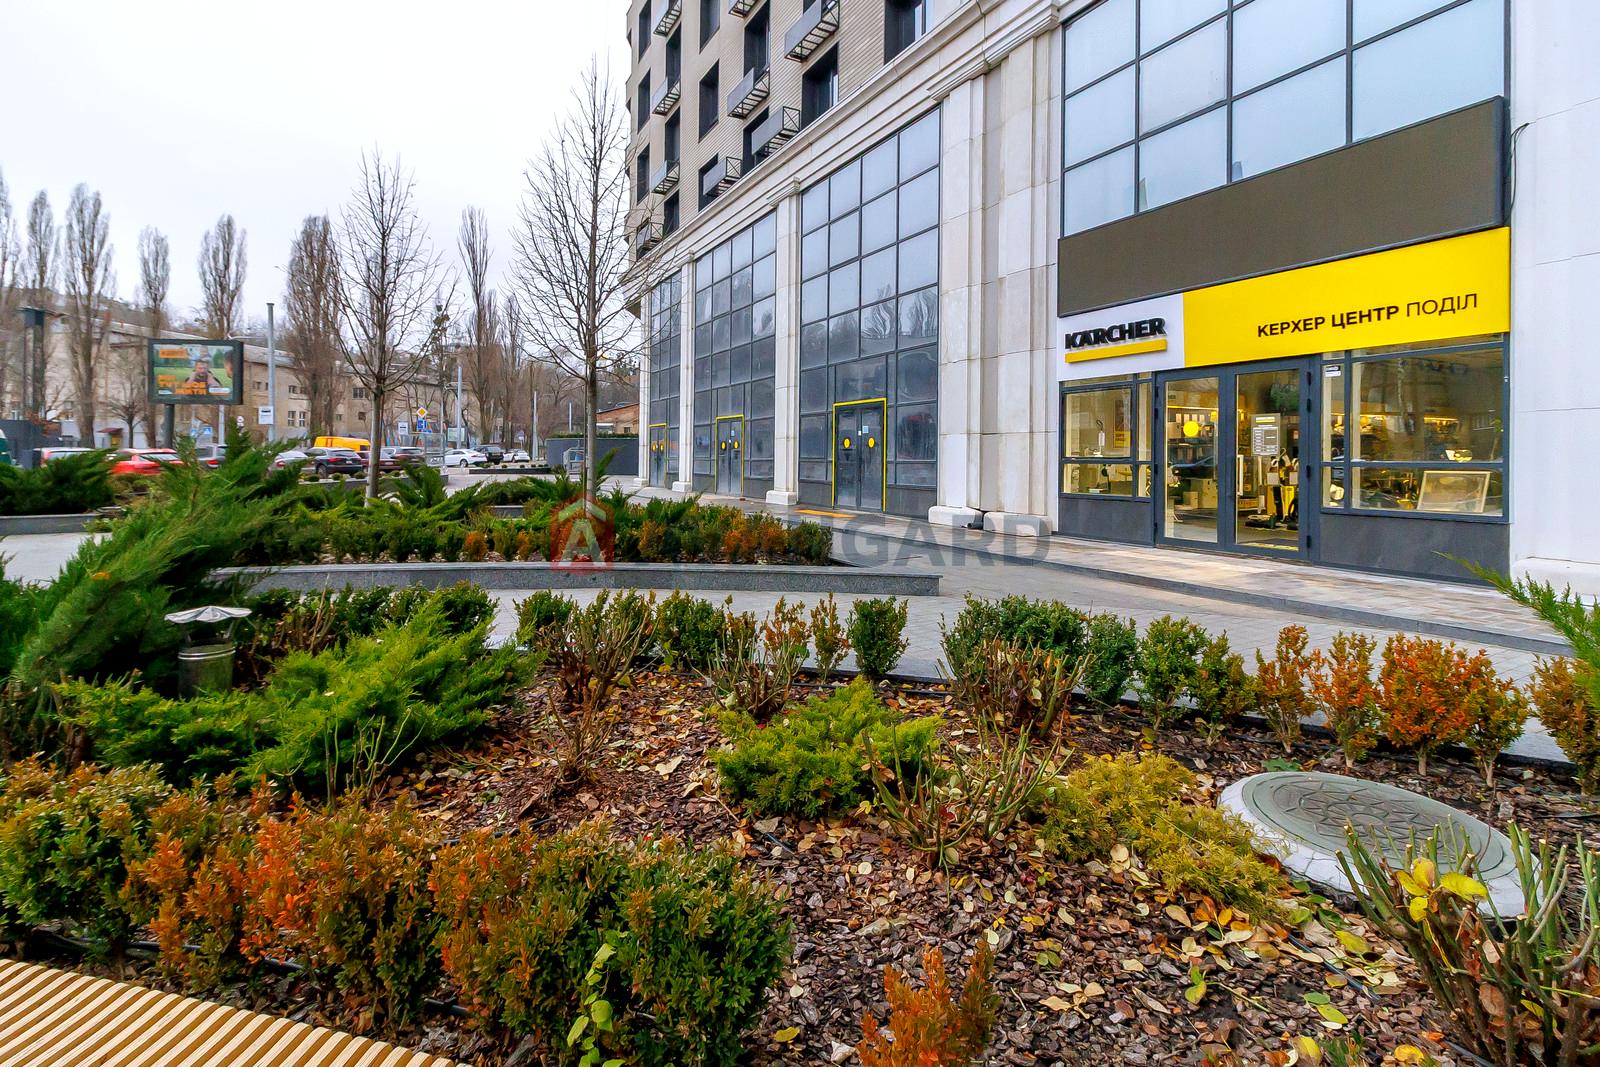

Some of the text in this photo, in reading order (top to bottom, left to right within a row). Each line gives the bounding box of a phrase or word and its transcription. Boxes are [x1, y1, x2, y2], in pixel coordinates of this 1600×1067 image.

[1257, 294, 1478, 337] КЕРХЕР ЦЕНТР ПОДІЛ
